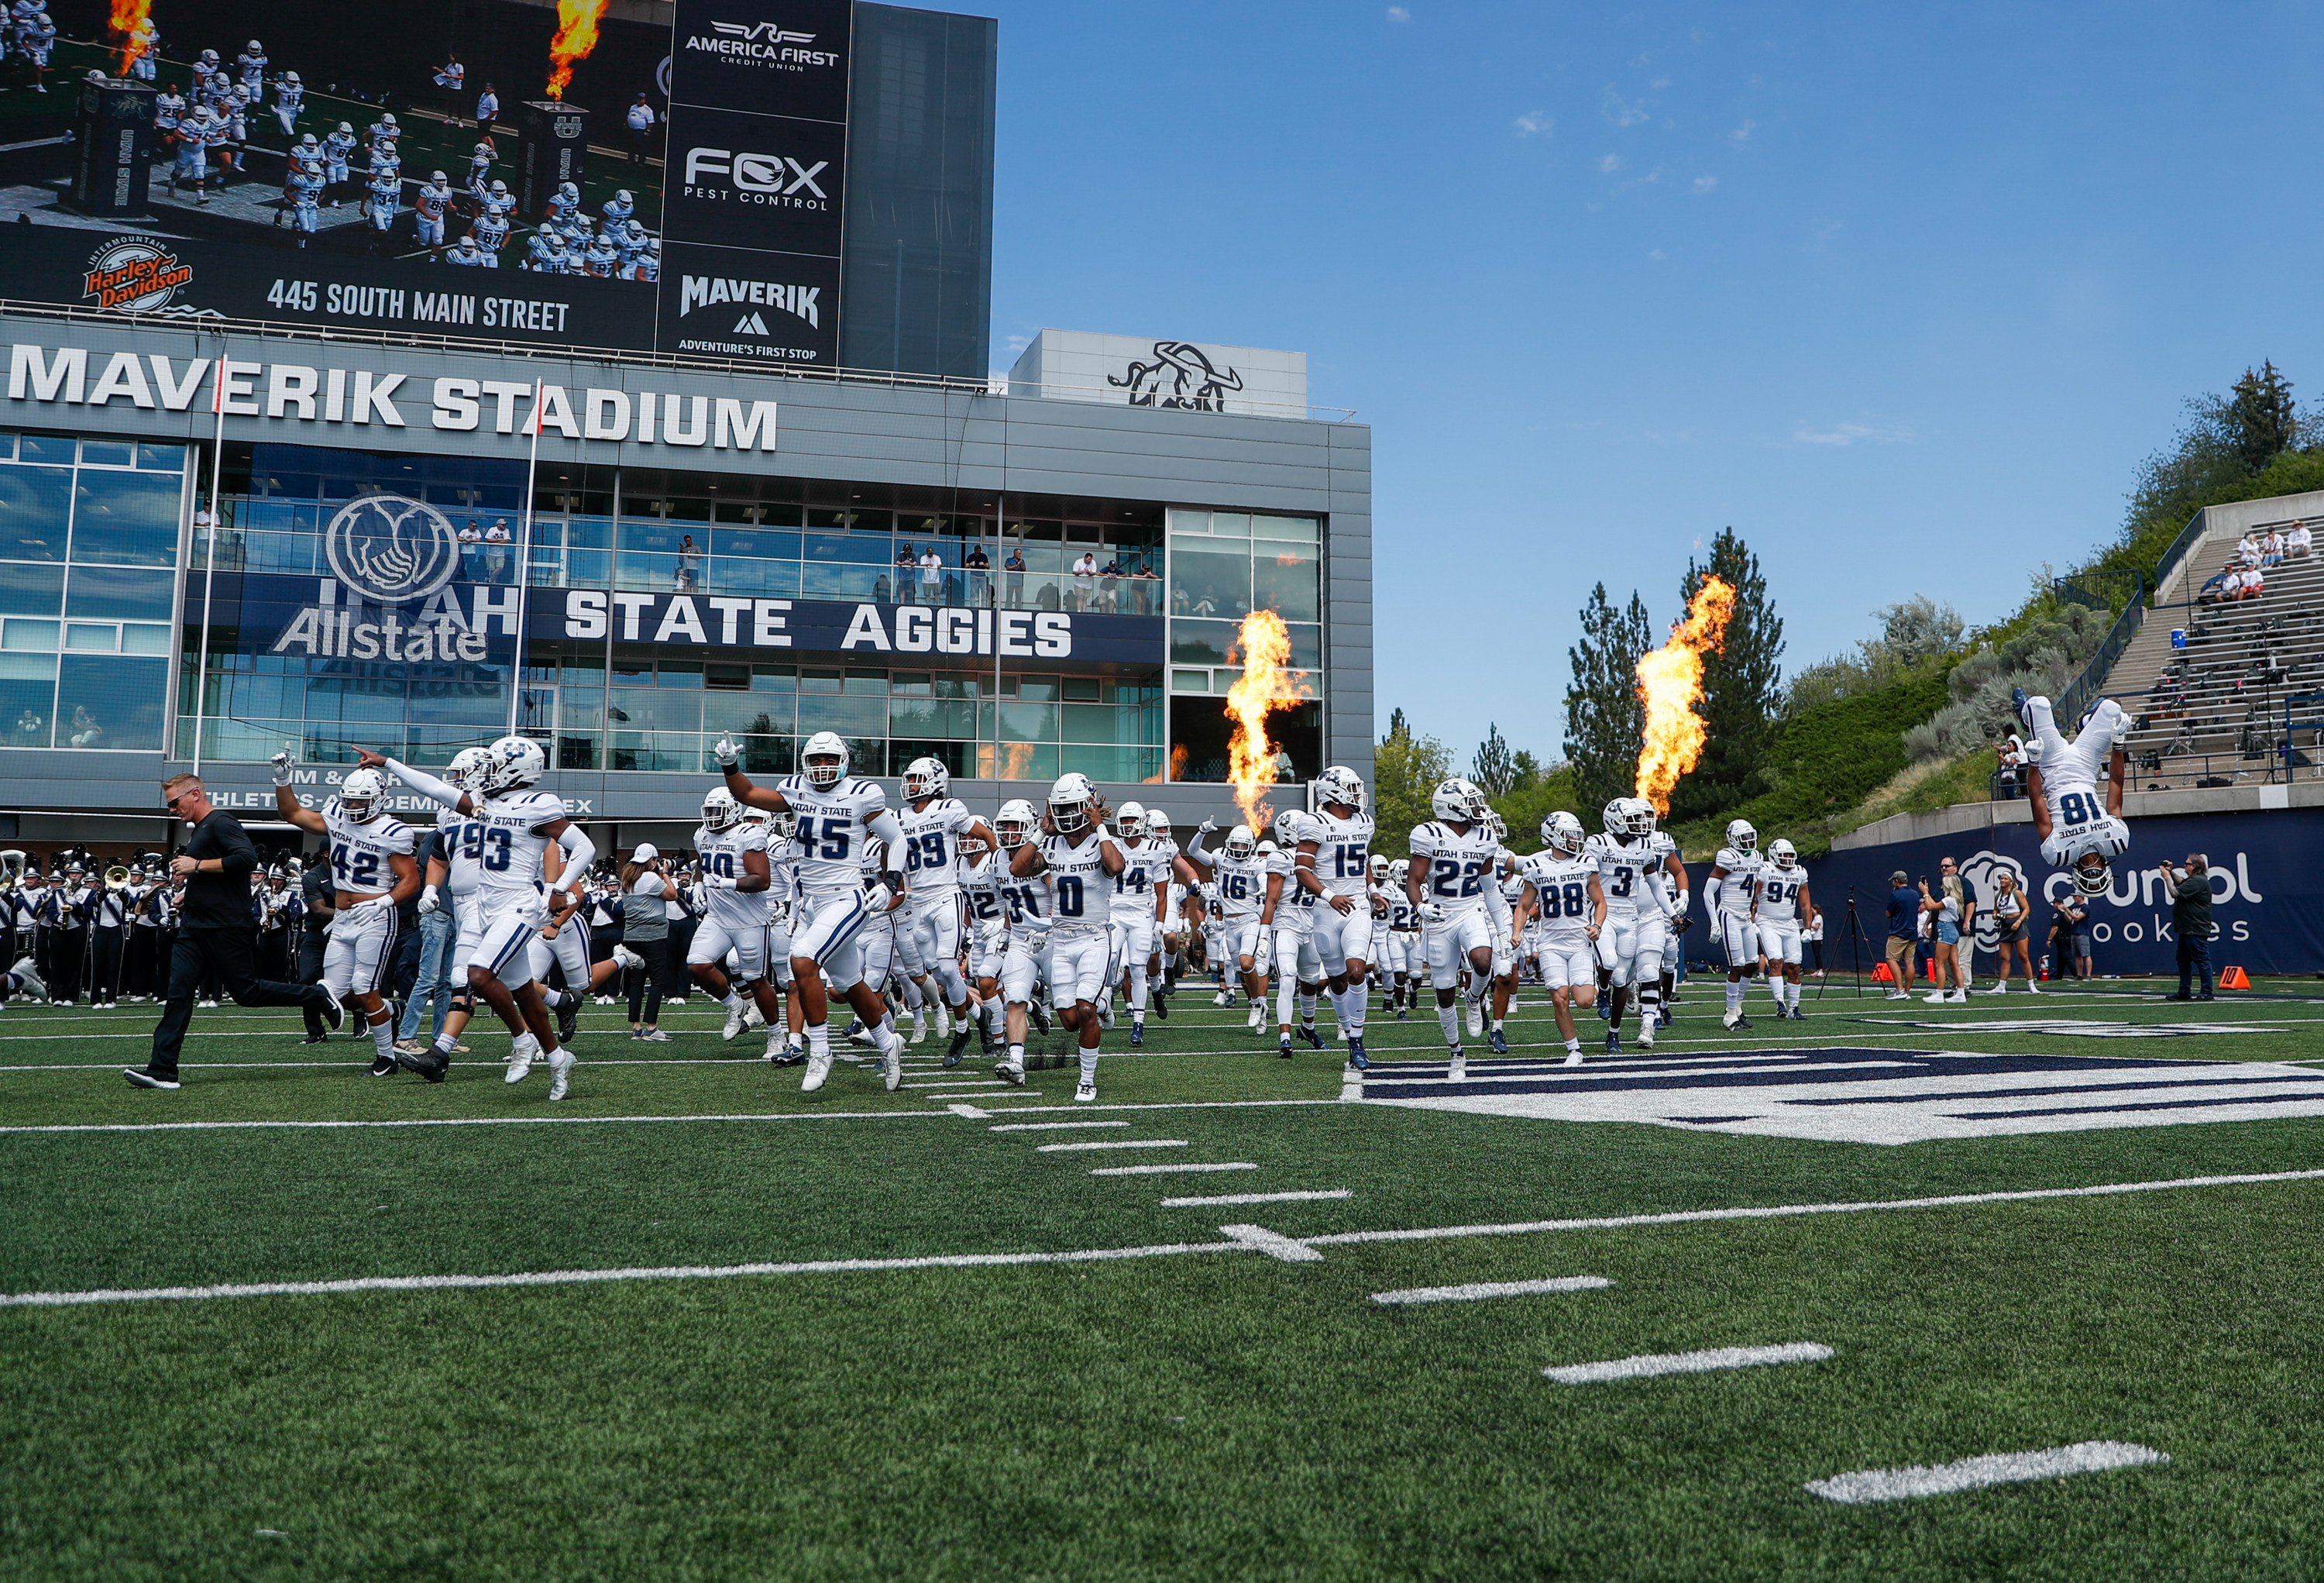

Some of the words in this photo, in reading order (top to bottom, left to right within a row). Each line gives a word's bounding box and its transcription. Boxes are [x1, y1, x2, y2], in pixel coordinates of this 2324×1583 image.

[686, 36, 777, 60] AMERICA
[781, 47, 839, 67] FIRST
[720, 56, 762, 67] CREDIT
[768, 62, 803, 72] UNION
[119, 129, 134, 164] UTAH
[559, 148, 572, 180] UTAH
[685, 147, 829, 199] FOX
[114, 167, 131, 207] STATE
[684, 187, 729, 201] PEST
[739, 193, 827, 212] CONTROL
[88, 236, 167, 265] INTERMOUNTAIN
[101, 267, 190, 308] Davidson
[266, 278, 318, 311] 445
[326, 283, 405, 319] SOUTH
[413, 290, 476, 325] MAIN
[483, 297, 569, 332] STREET
[680, 274, 820, 330] MAVERIK
[679, 339, 754, 355] ADVENTURE'S
[756, 346, 787, 358] FIRST
[789, 348, 817, 360] STOP
[8, 343, 407, 427] MAVERIK
[431, 376, 777, 452] STADIUM
[273, 607, 488, 662] Allstate
[565, 589, 793, 648] STATE
[840, 602, 1072, 658] AGGIES
[325, 770, 343, 785] &
[494, 816, 526, 828] STATE
[792, 802, 817, 814] UTAH
[821, 807, 852, 817] STATE
[2060, 793, 2102, 826] 18
[795, 816, 852, 860] 45
[919, 821, 945, 833] STATE
[2059, 826, 2086, 839] STATE
[2090, 821, 2113, 832] UTAH
[331, 829, 352, 844] UTAH
[355, 840, 380, 853] STATE
[1433, 849, 1458, 859] UTAH
[1462, 852, 1486, 860] STATE
[331, 843, 380, 886] 42
[1070, 861, 1101, 872] STATE
[1219, 865, 1234, 873] UTAH
[1336, 844, 1366, 878] 15
[1602, 855, 1622, 865] UTAH
[1012, 876, 1038, 884] STATE
[1116, 867, 1147, 894] 14
[1222, 873, 1247, 900] 16
[1434, 860, 1482, 898] 22
[1535, 876, 1556, 885] UTAH
[1560, 873, 1585, 882] STATE
[1611, 866, 1633, 897] 3
[1739, 873, 1755, 898] 4
[1002, 884, 1040, 923] 31
[1057, 876, 1083, 917] 0
[1541, 883, 1584, 919] 88
[1767, 882, 1799, 905] 94
[1394, 907, 1420, 927] 22
[2225, 966, 2238, 985] 10
